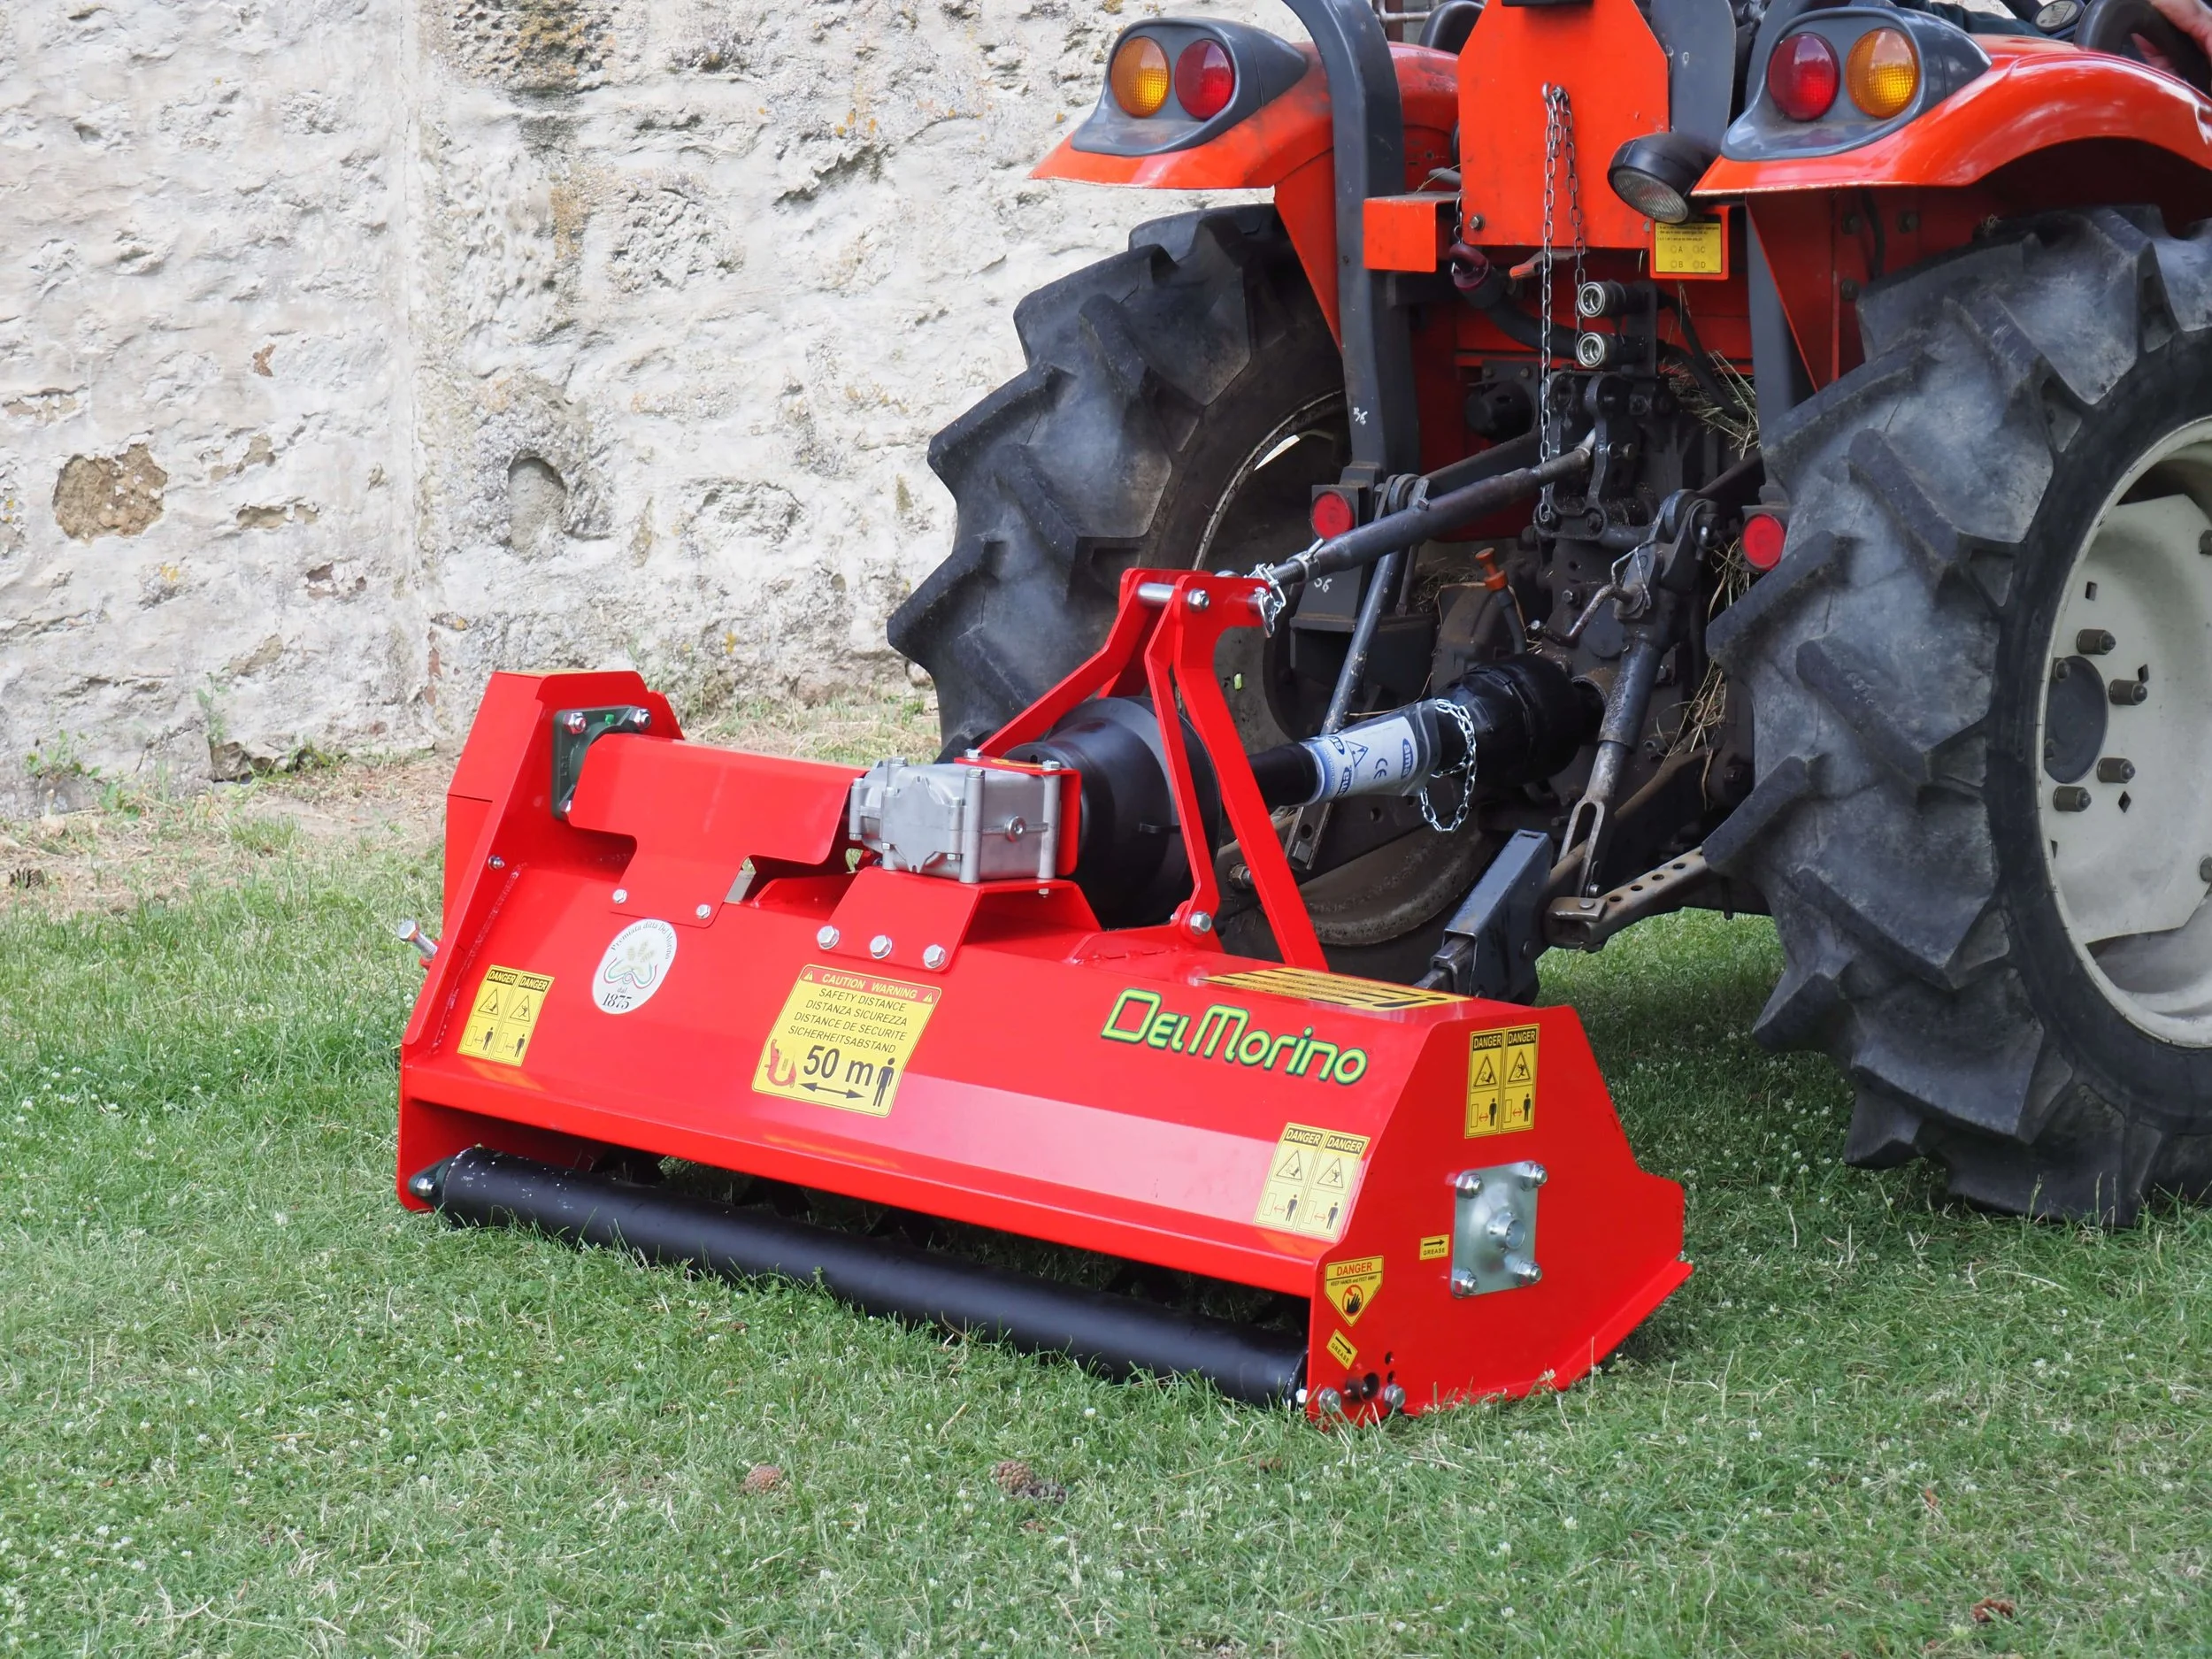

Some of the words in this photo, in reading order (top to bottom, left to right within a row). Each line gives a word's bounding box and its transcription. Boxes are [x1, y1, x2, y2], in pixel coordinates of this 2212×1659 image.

[488, 970, 517, 984] DANGER
[519, 976, 548, 991] DANGER
[822, 973, 866, 990] CAUTION
[871, 981, 918, 1000] WARNING
[602, 992, 633, 1010] 1875
[818, 987, 857, 1003] SAFETY
[857, 995, 908, 1012] DISTANCE
[805, 999, 852, 1017] DISTANZA
[853, 1009, 908, 1027] SICUREZZA
[794, 1011, 841, 1028] DISTANCE
[843, 1021, 856, 1032] DE
[857, 1025, 908, 1041] SECURITE
[787, 1025, 897, 1054] SICHERHEITSABSTAND
[1473, 1034, 1502, 1049] DANGER
[1508, 1030, 1536, 1045] DANGER
[803, 1044, 841, 1079] 50
[845, 1059, 874, 1087] m
[1286, 1129, 1322, 1145] DANGER
[1326, 1136, 1363, 1153] DANGER
[1423, 1247, 1446, 1256] GREASE
[1336, 1261, 1373, 1277] DANGER
[1330, 1341, 1350, 1364] GREASE
